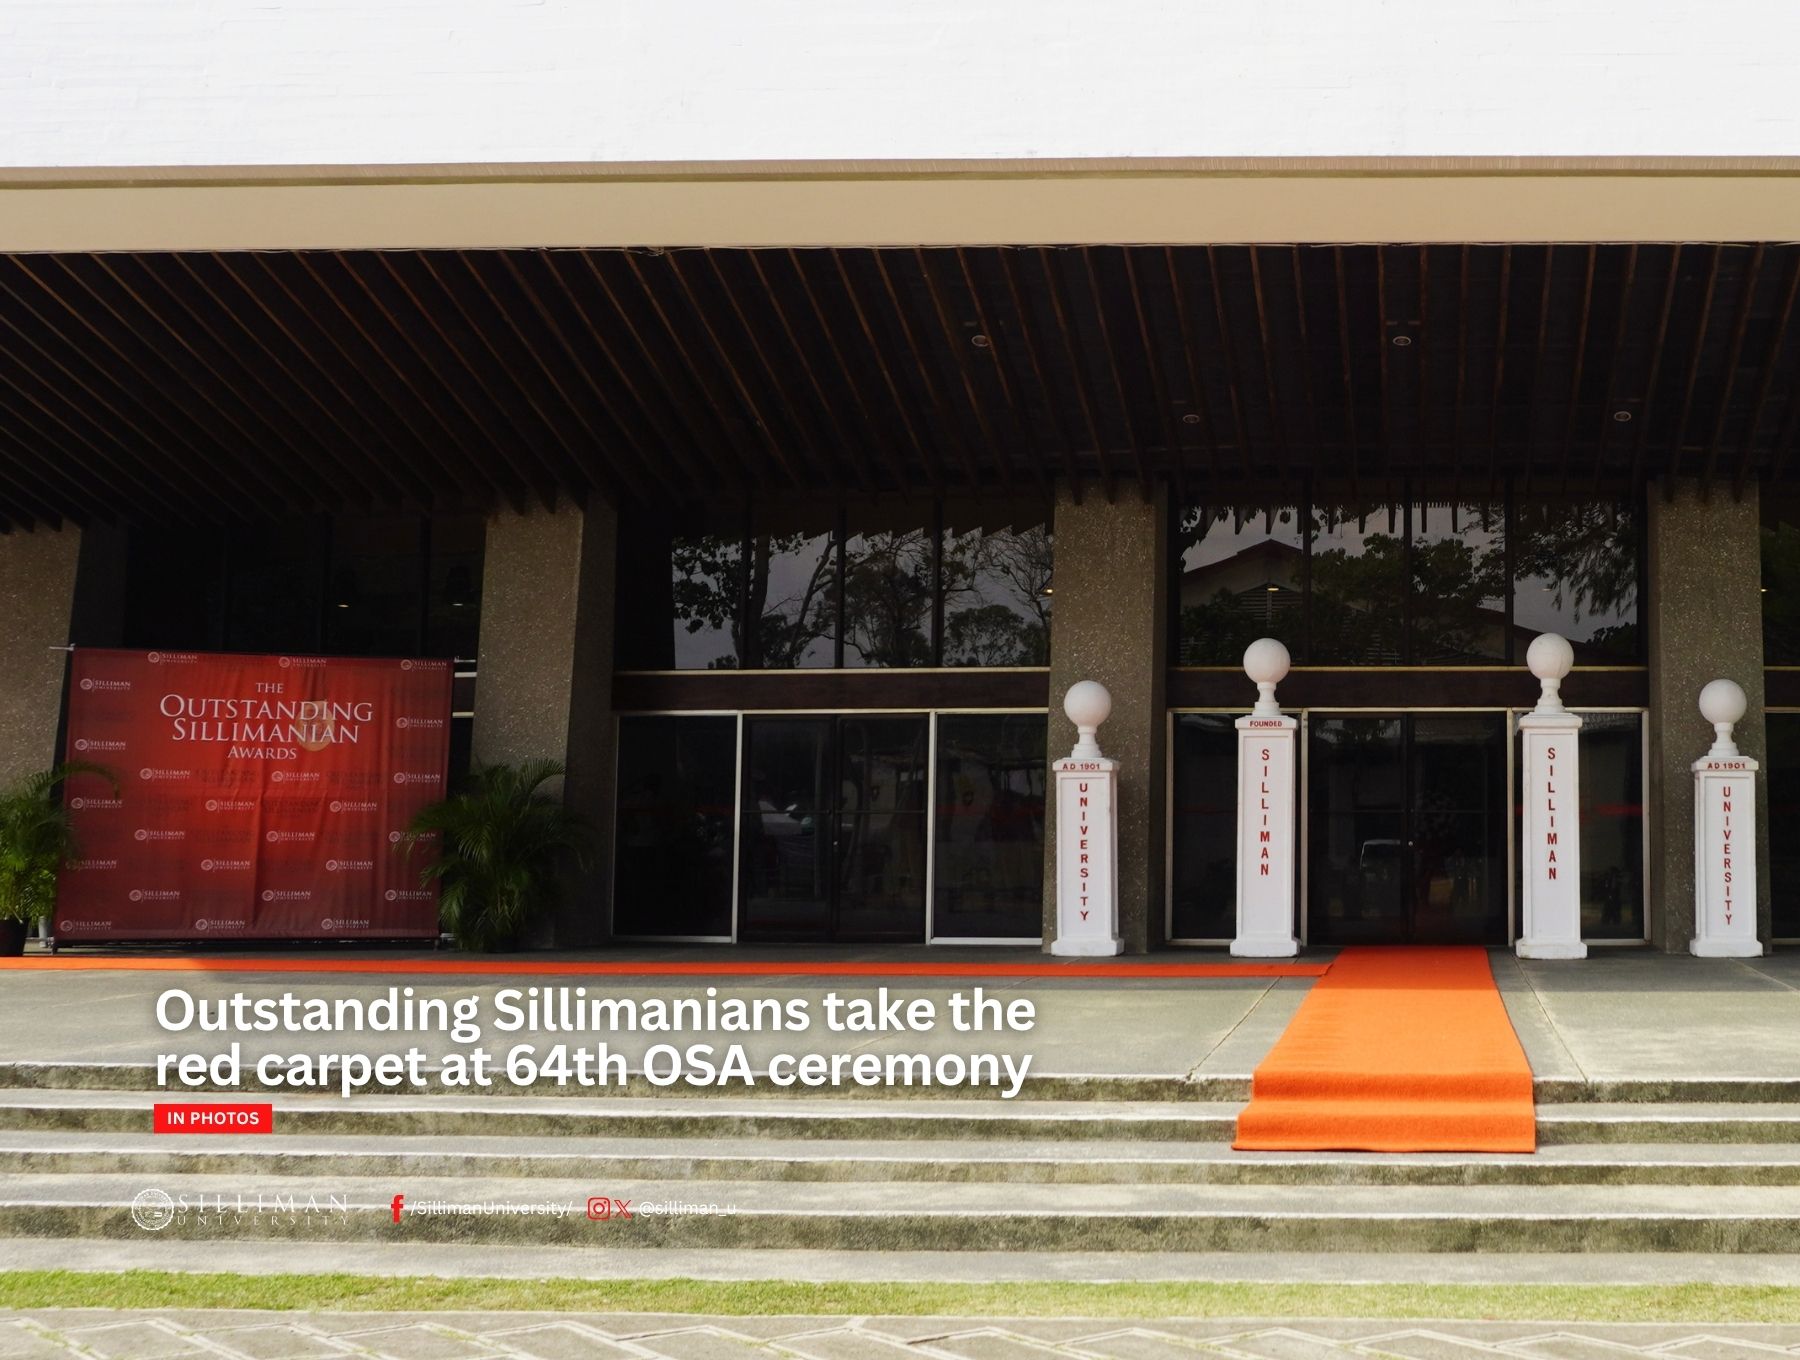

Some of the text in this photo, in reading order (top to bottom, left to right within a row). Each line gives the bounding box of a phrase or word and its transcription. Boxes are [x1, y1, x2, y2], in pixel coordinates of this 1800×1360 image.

[160, 693, 374, 722] OUTSTANDING
[256, 682, 284, 694] THE
[172, 717, 359, 744] SILLIMANIAN
[228, 746, 297, 760] AWARDS
[1260, 749, 1270, 876] SILLIMAN
[1547, 747, 1557, 880] SILLIMAN
[1079, 783, 1089, 921] UNIVERSITY
[1723, 786, 1732, 925] UNIVERSITY
